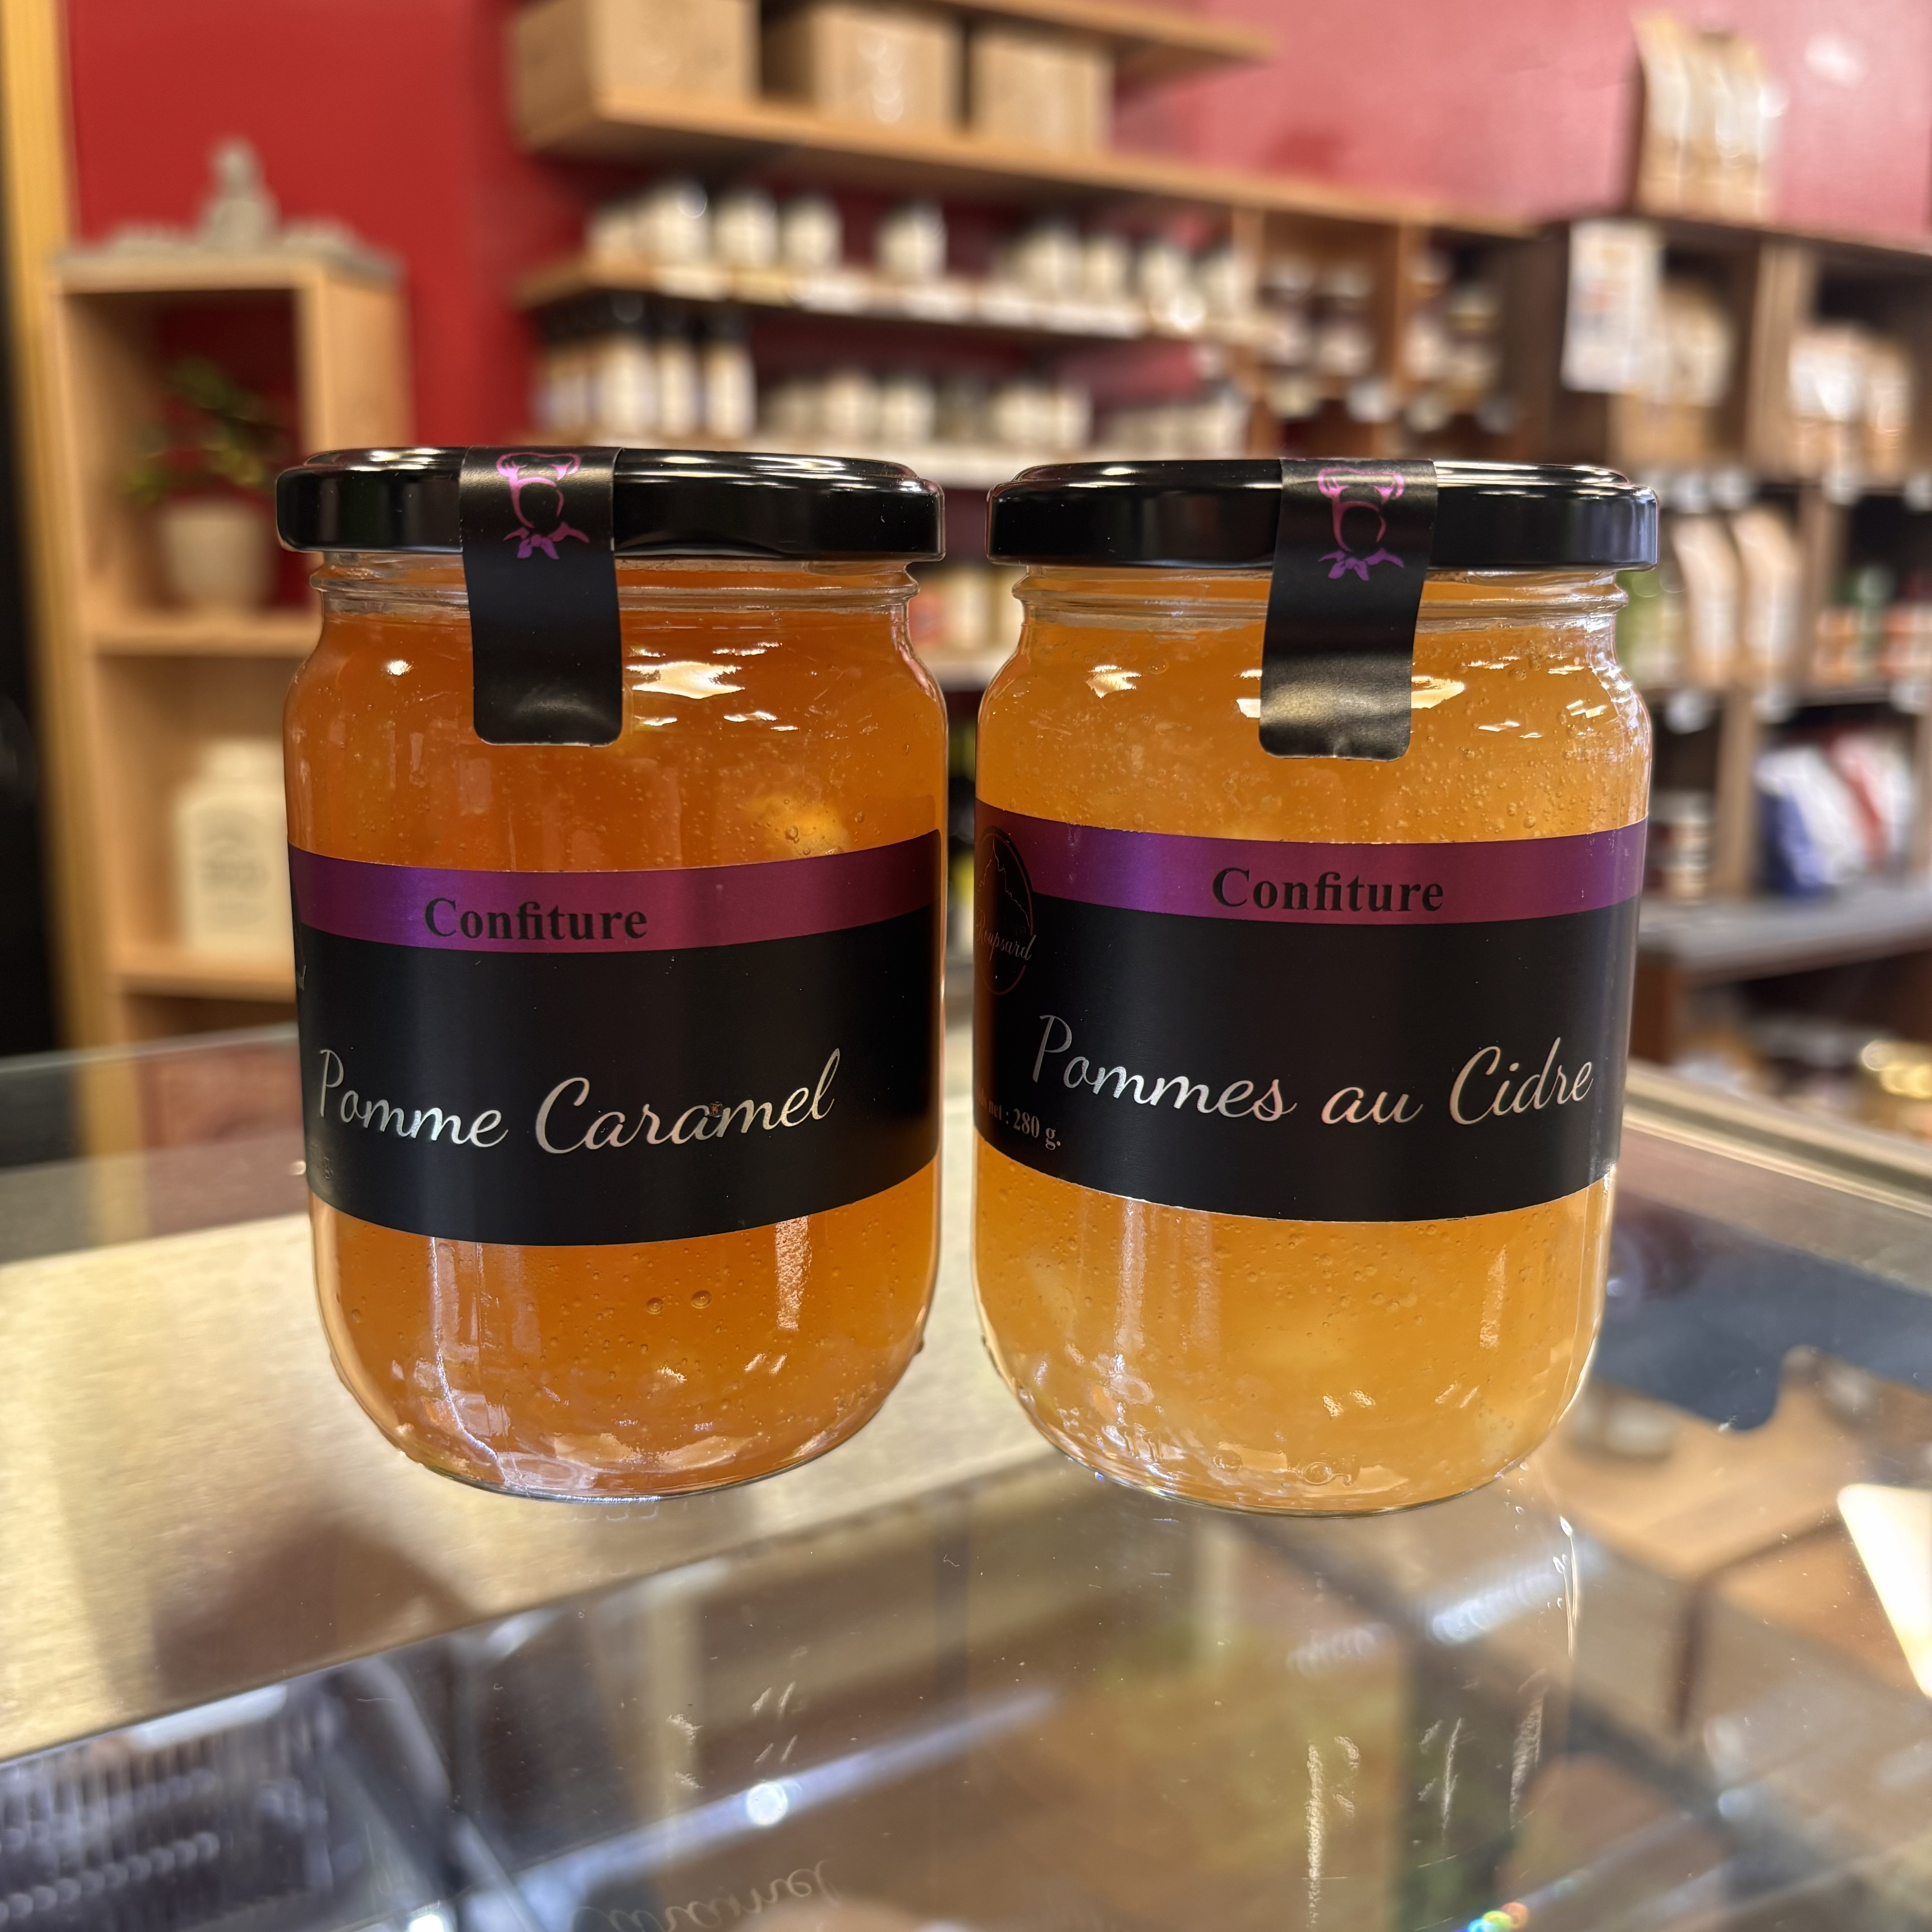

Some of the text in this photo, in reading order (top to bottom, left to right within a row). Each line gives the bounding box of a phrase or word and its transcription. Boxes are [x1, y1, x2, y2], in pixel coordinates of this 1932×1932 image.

[1213, 868, 1444, 911] Confiture
[425, 898, 648, 941] Confiture
[1032, 1015, 1594, 1125] Pommes au Cidre
[320, 1049, 841, 1154] Pomme Caramel
[1013, 1108, 1040, 1138] 280
[1045, 1127, 1061, 1150] g.
